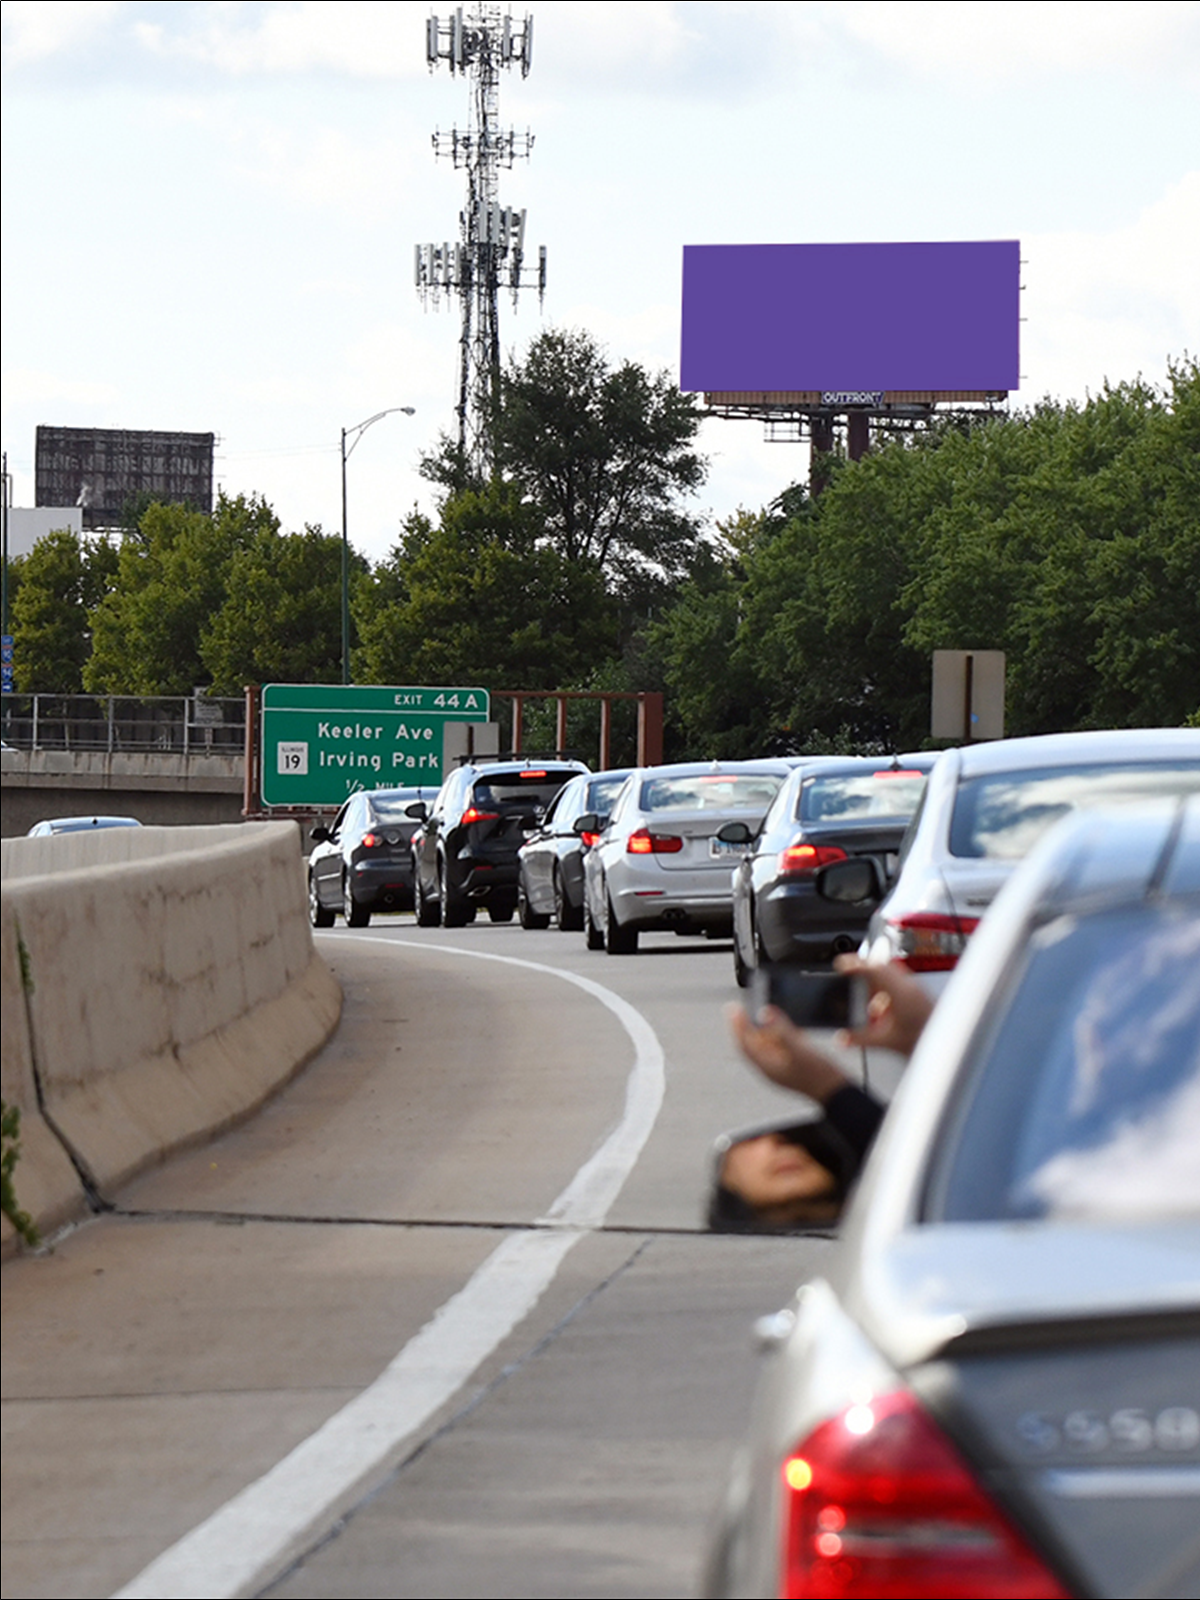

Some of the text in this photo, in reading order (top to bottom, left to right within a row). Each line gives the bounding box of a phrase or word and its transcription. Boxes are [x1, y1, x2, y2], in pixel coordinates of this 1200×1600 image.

[823, 391, 881, 403] OUTFRONT
[394, 694, 423, 705] EXIT
[318, 722, 433, 740] Keeler Ave
[285, 754, 301, 769] 19
[319, 751, 439, 772] Irving Park
